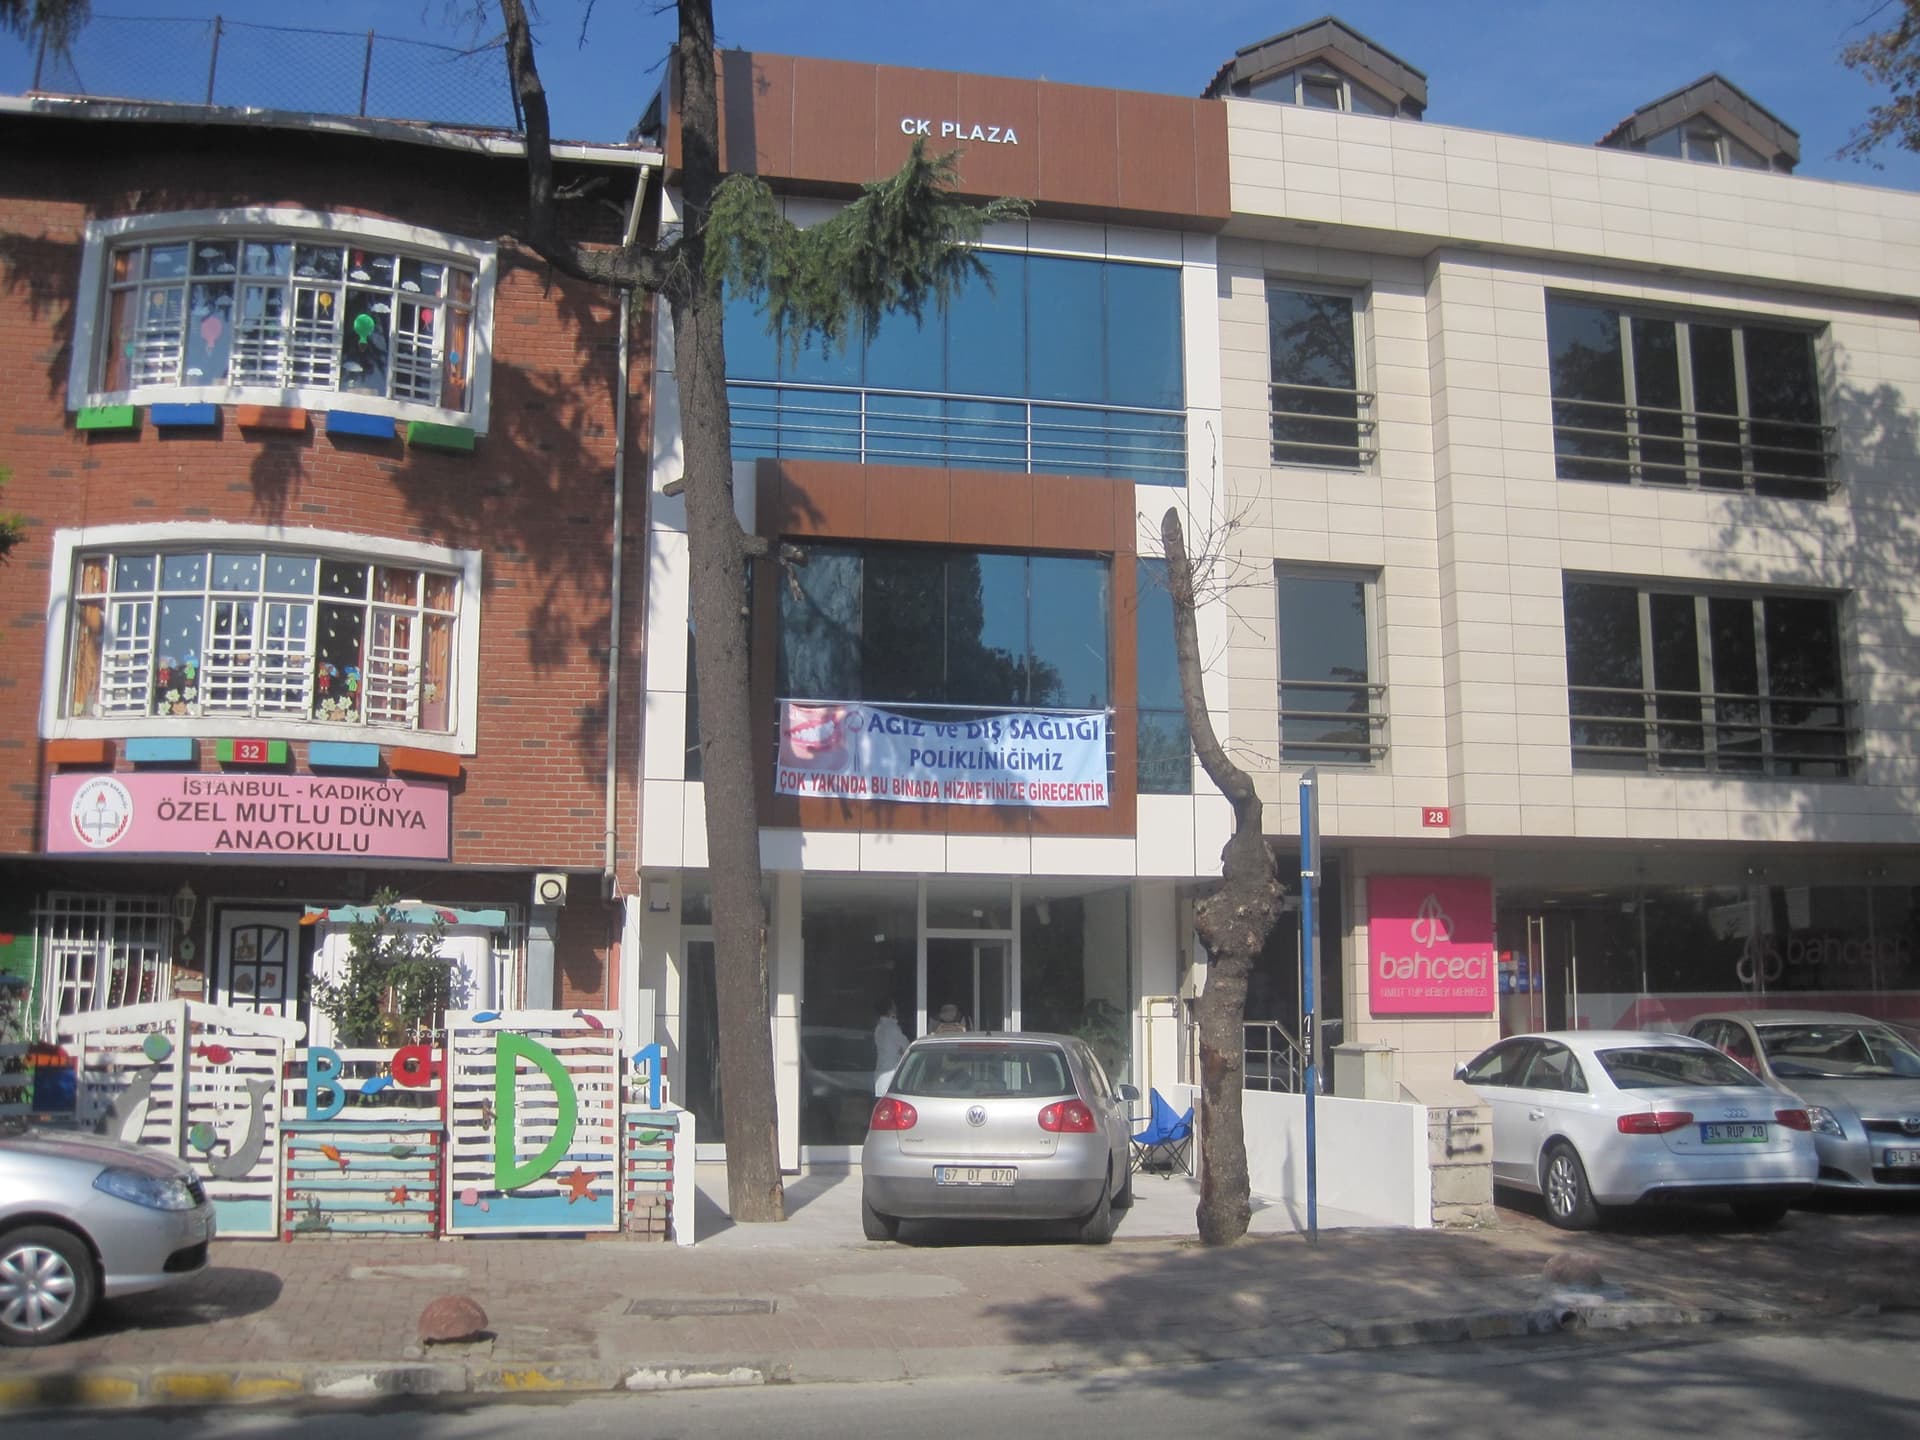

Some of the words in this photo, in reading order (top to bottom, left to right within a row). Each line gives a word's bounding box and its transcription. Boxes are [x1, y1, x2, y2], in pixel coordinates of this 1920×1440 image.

[901, 119, 931, 136] CK
[942, 122, 1018, 145] PLAZA
[936, 724, 958, 738] ve
[1010, 717, 1098, 741] SAĞLIĞI
[241, 744, 259, 759] 32
[910, 746, 1063, 771] POLİKLİNİĞİMİZ
[183, 777, 289, 798] İSTANBUL
[310, 784, 404, 803] KADIKÖY
[780, 770, 805, 792] ÇOK
[811, 773, 867, 794] YAKINDA
[872, 777, 888, 794] BU
[893, 775, 939, 798] BİNADA
[944, 778, 1025, 800] HİZMETİNİZE
[1029, 779, 1104, 801] GİRECEKTİR
[157, 798, 226, 822] ÖZEL
[236, 803, 330, 825] MUTLU
[340, 803, 426, 830] DÜNYA
[1429, 811, 1444, 824] 28
[215, 830, 370, 852] ANAOKULU
[1380, 951, 1487, 983] bahçeci
[1707, 1125, 1720, 1138] 34
[944, 1168, 958, 1181] 67
[992, 1169, 1012, 1182] 070
